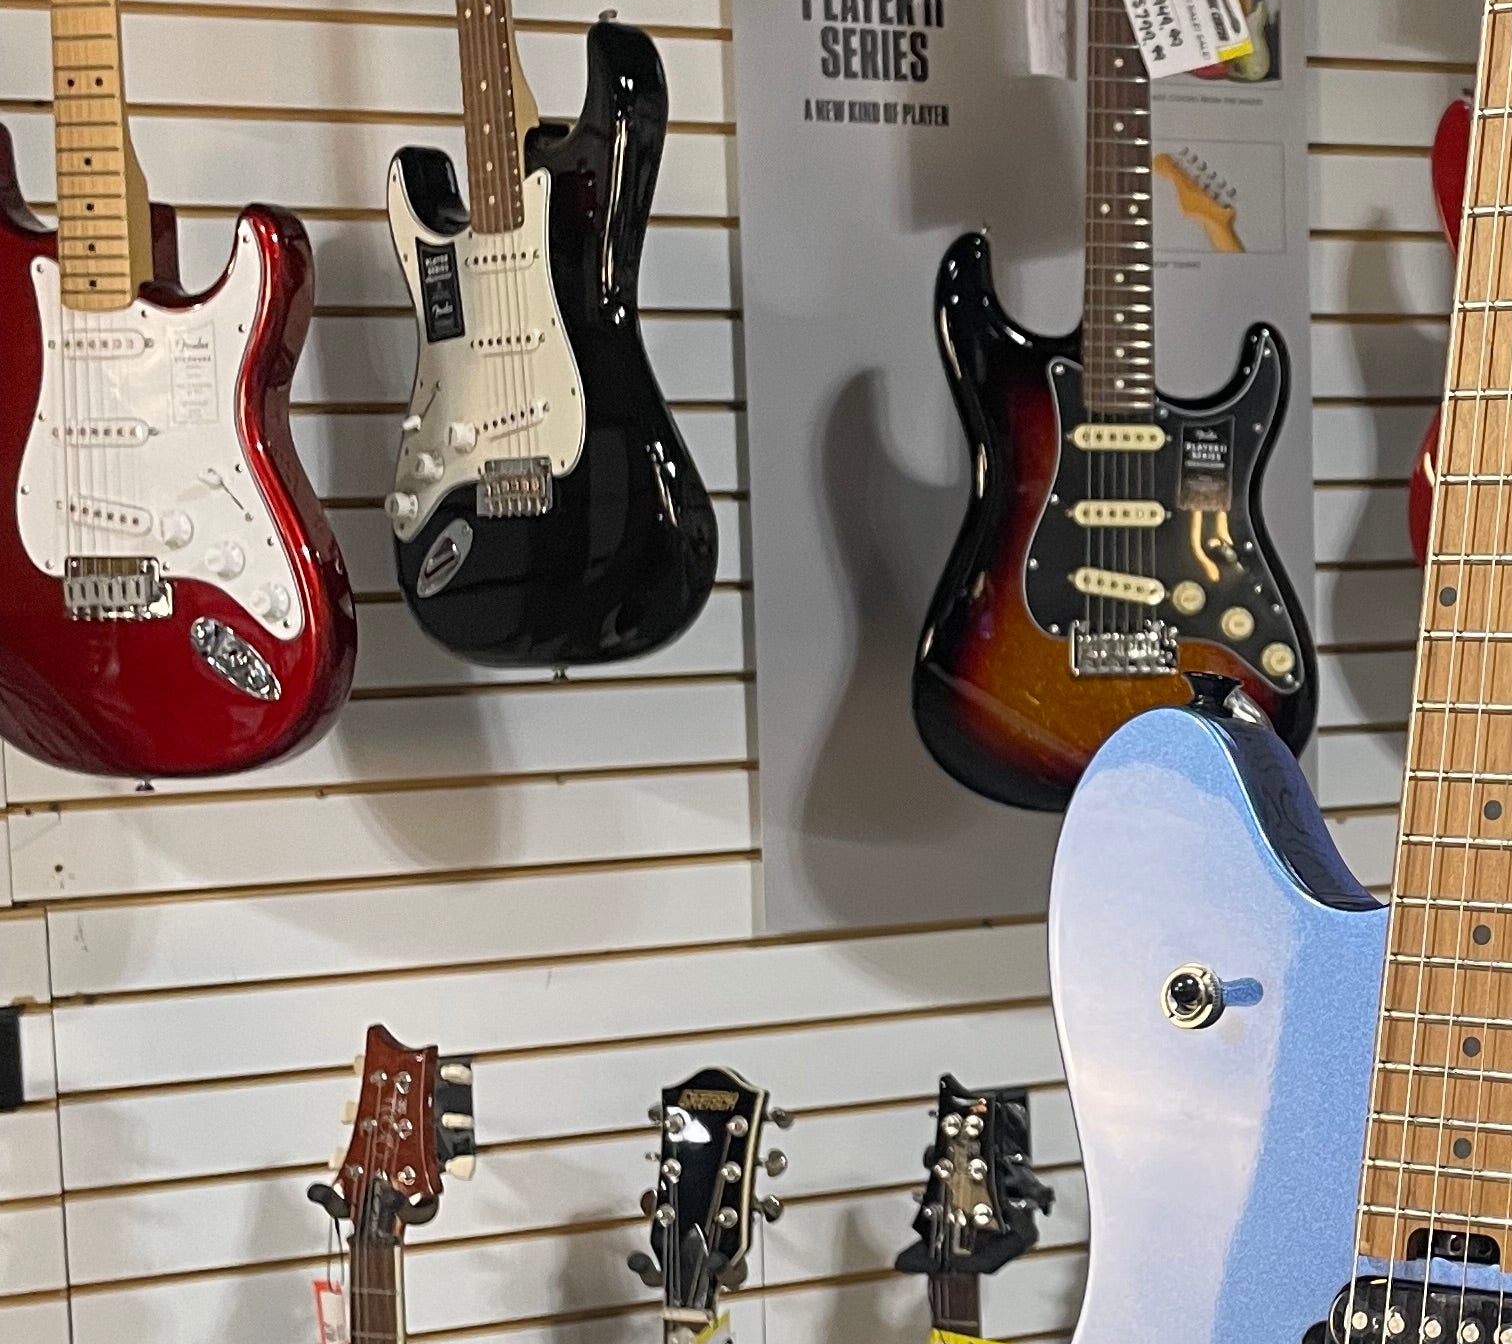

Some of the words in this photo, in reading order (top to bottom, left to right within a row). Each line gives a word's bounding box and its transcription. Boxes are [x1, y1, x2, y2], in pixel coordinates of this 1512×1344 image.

[820, 26, 929, 82] SERIES
[804, 98, 814, 122] A
[815, 99, 845, 123] NEW
[848, 100, 880, 124] KIND
[883, 101, 898, 125] OF
[902, 103, 949, 127] PLAYER
